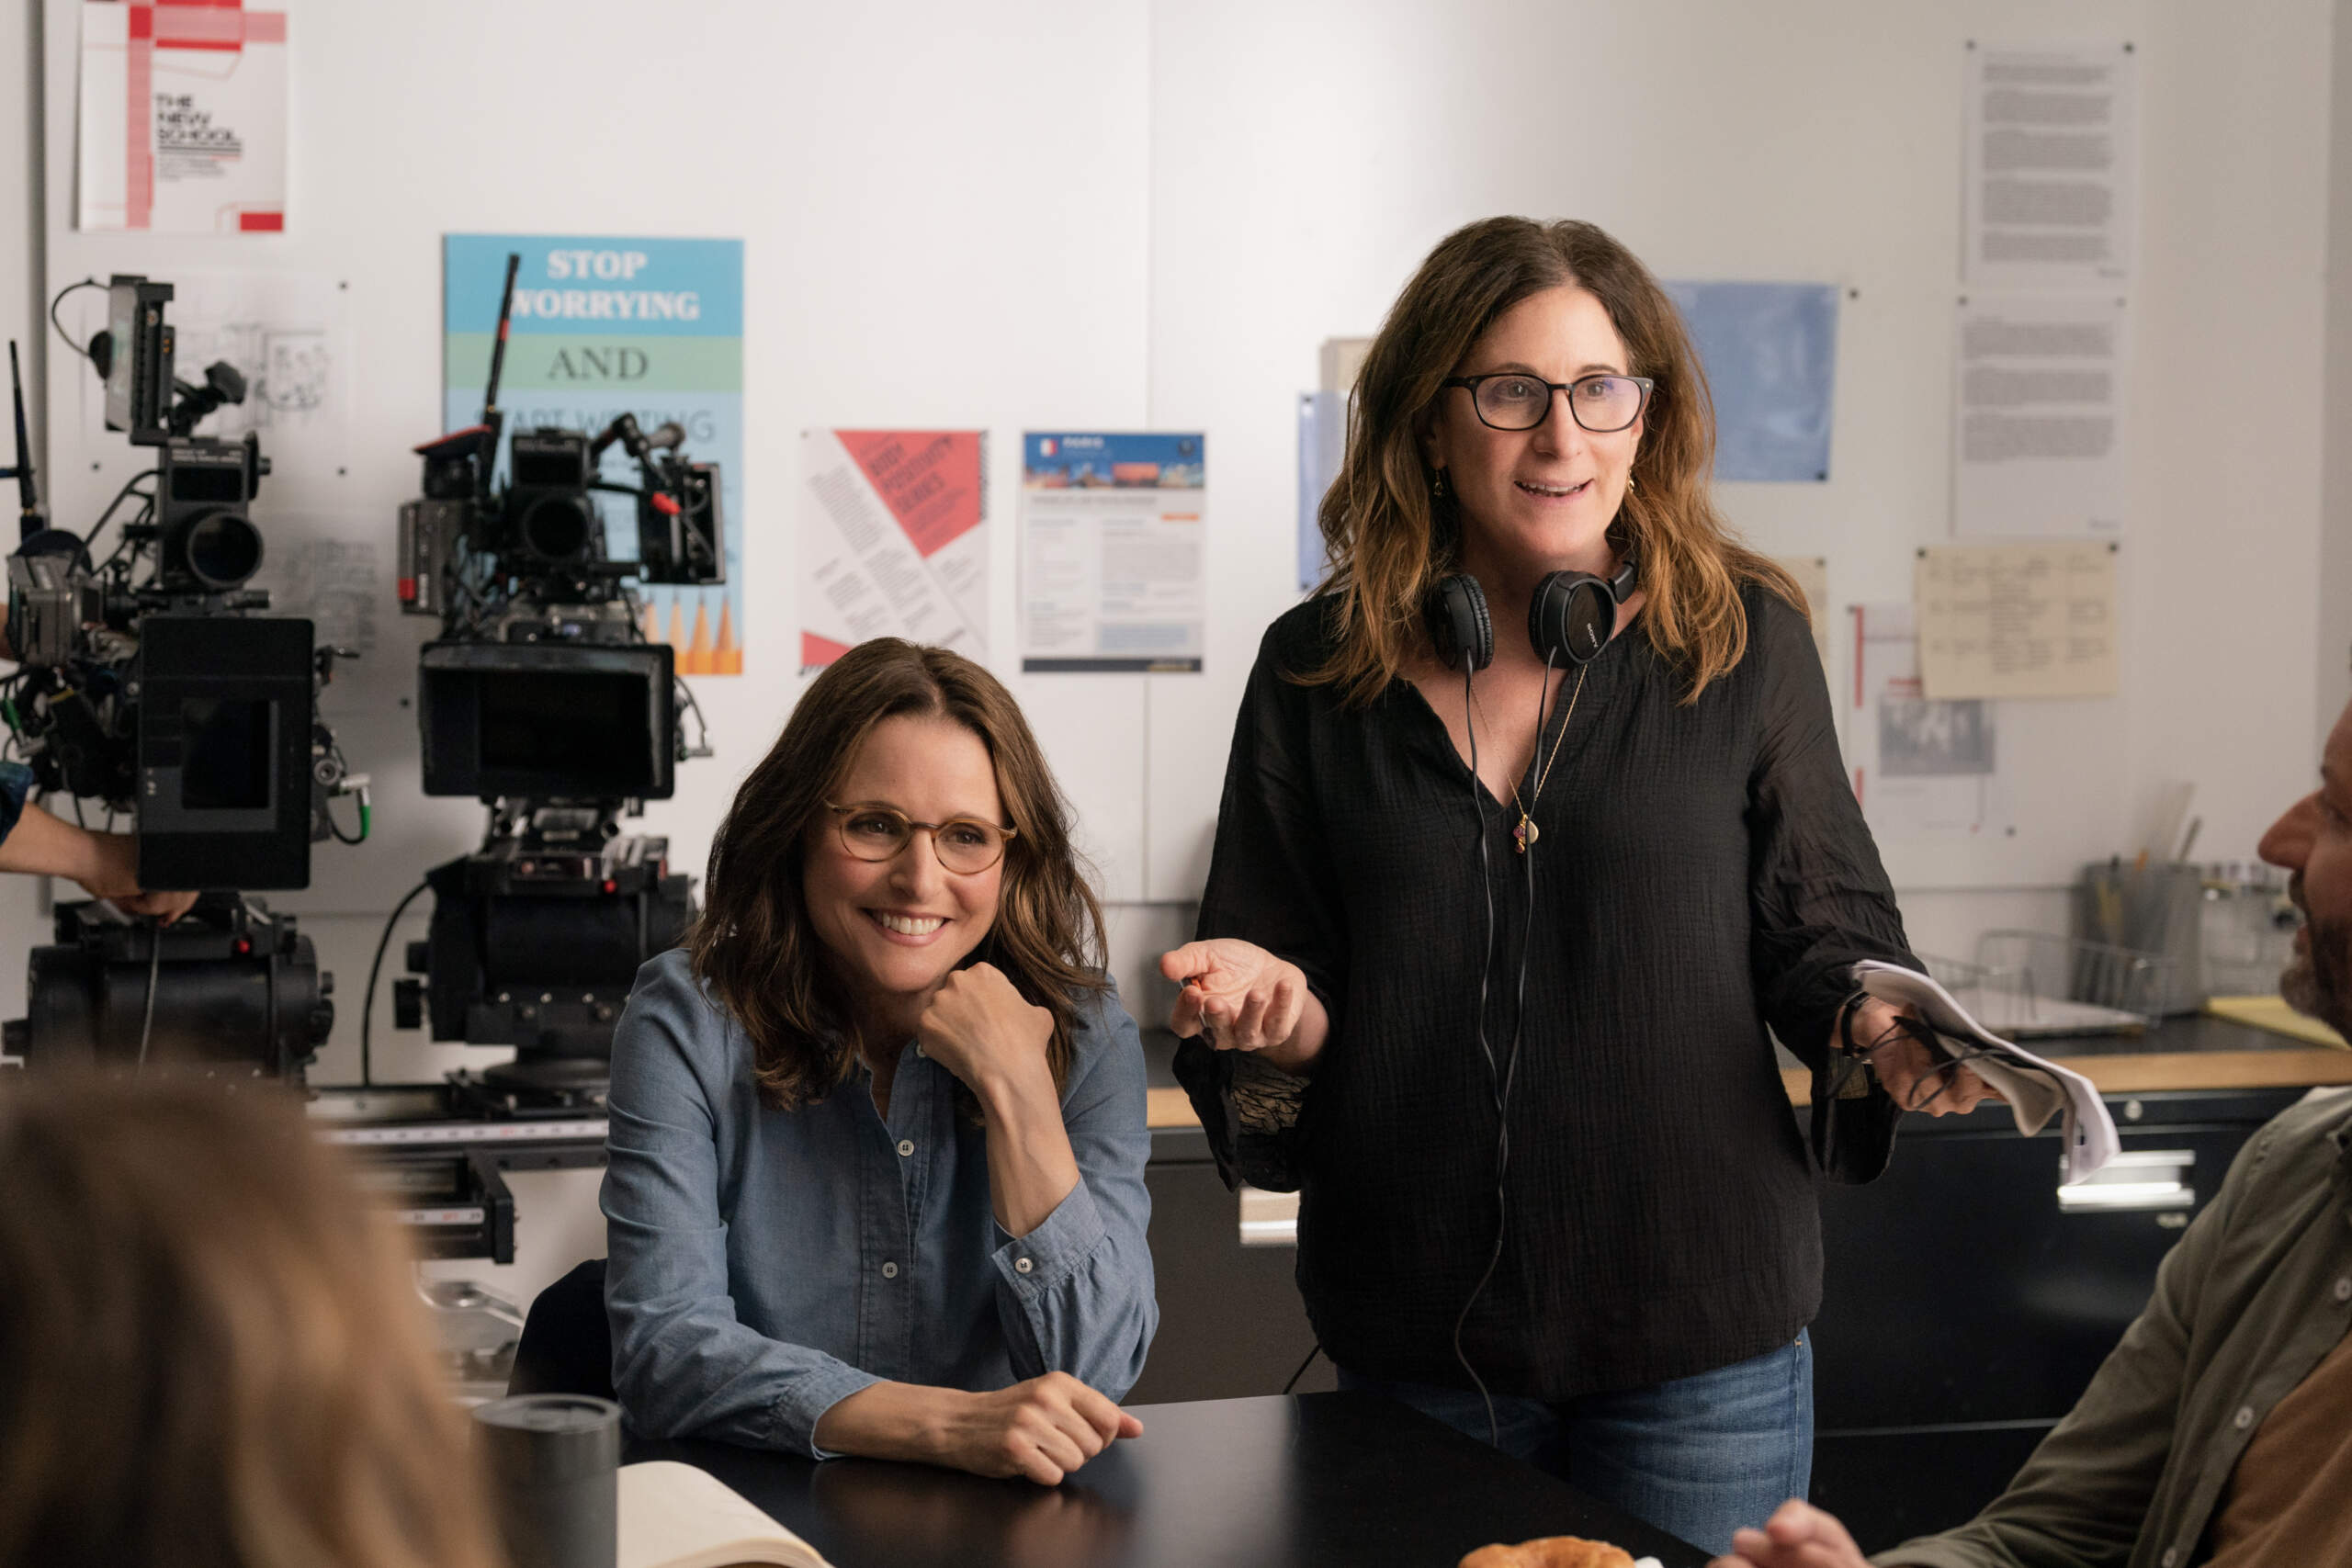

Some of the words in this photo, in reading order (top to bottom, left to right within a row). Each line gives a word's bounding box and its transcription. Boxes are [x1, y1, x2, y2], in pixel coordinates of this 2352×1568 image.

[157, 111, 210, 127] NEW
[157, 128, 241, 145] SCHOOL
[547, 249, 648, 279] STOP
[510, 288, 701, 320] WORRYING
[548, 345, 649, 379] AND
[1587, 623, 1599, 648] SONY
